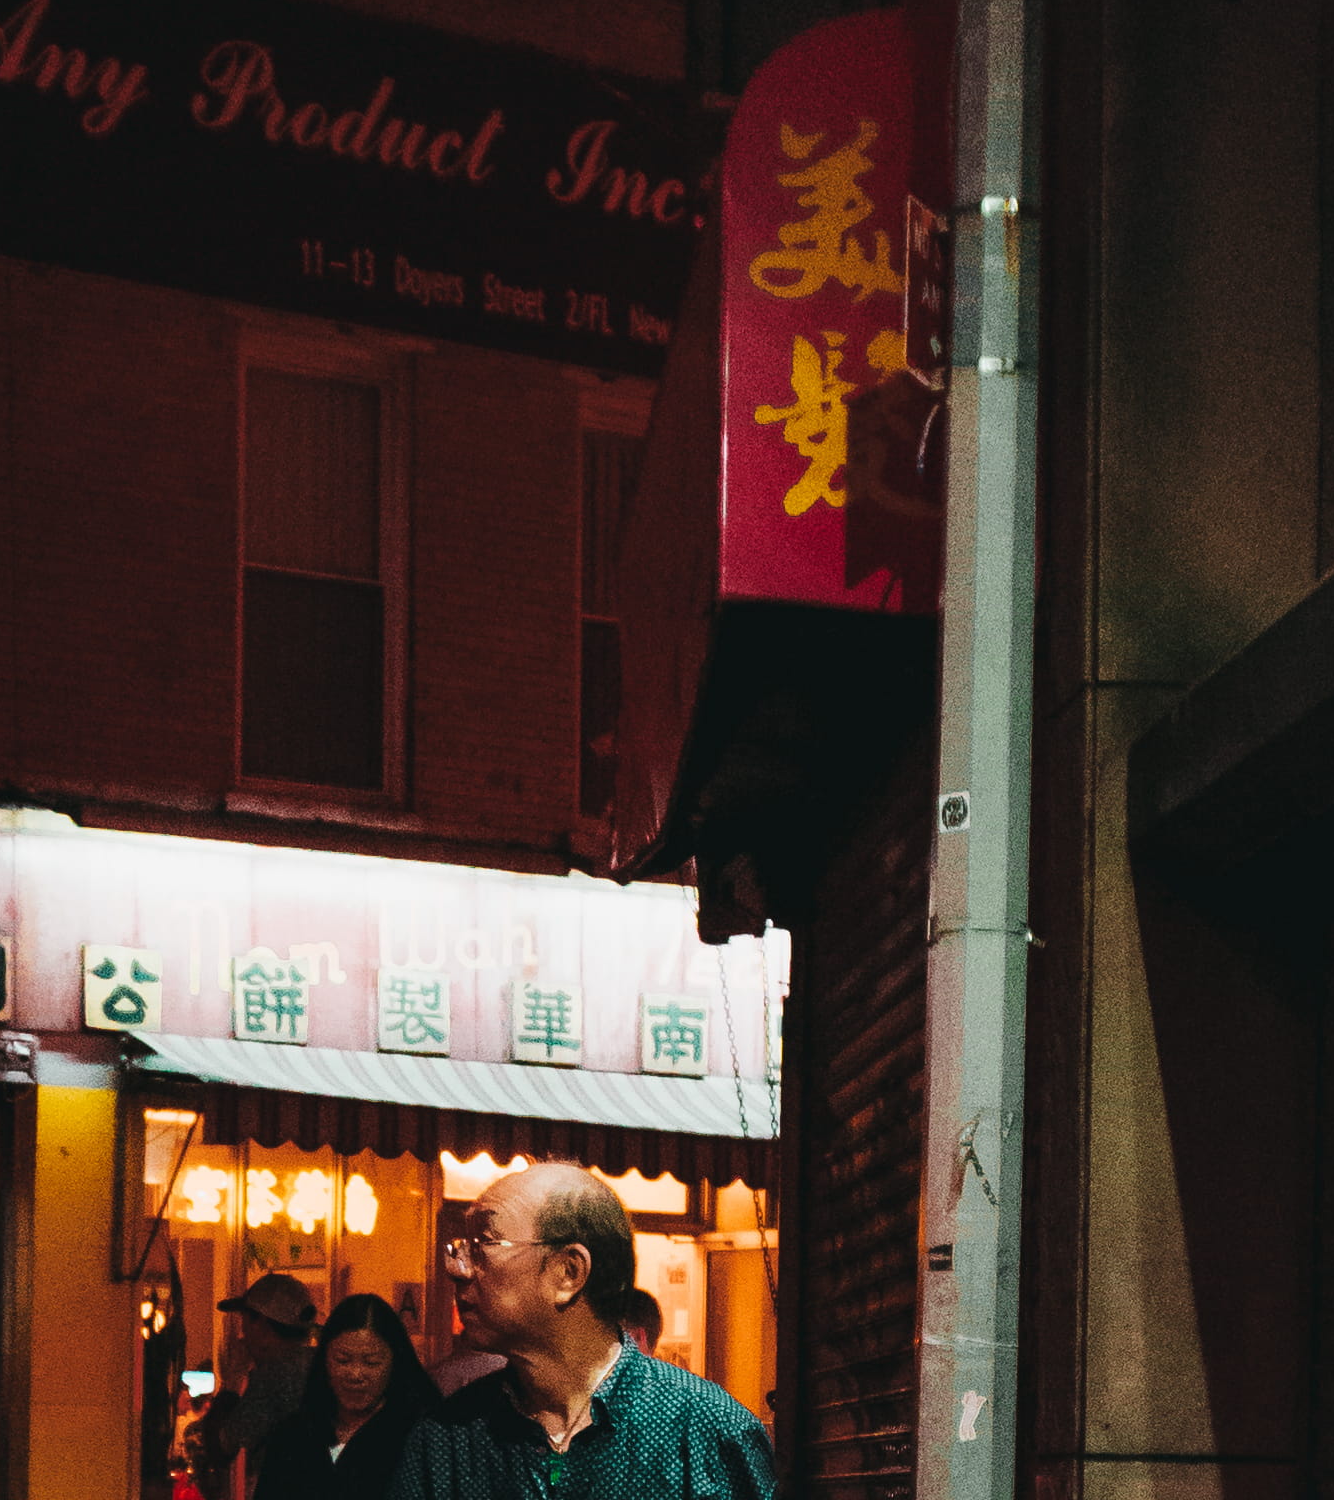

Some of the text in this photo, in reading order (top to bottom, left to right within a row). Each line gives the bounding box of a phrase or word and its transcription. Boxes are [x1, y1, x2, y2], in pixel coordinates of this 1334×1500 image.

[191, 39, 505, 186] Product
[545, 119, 707, 230] Inc.
[393, 253, 465, 308] Doyers
[482, 271, 546, 324] Street
